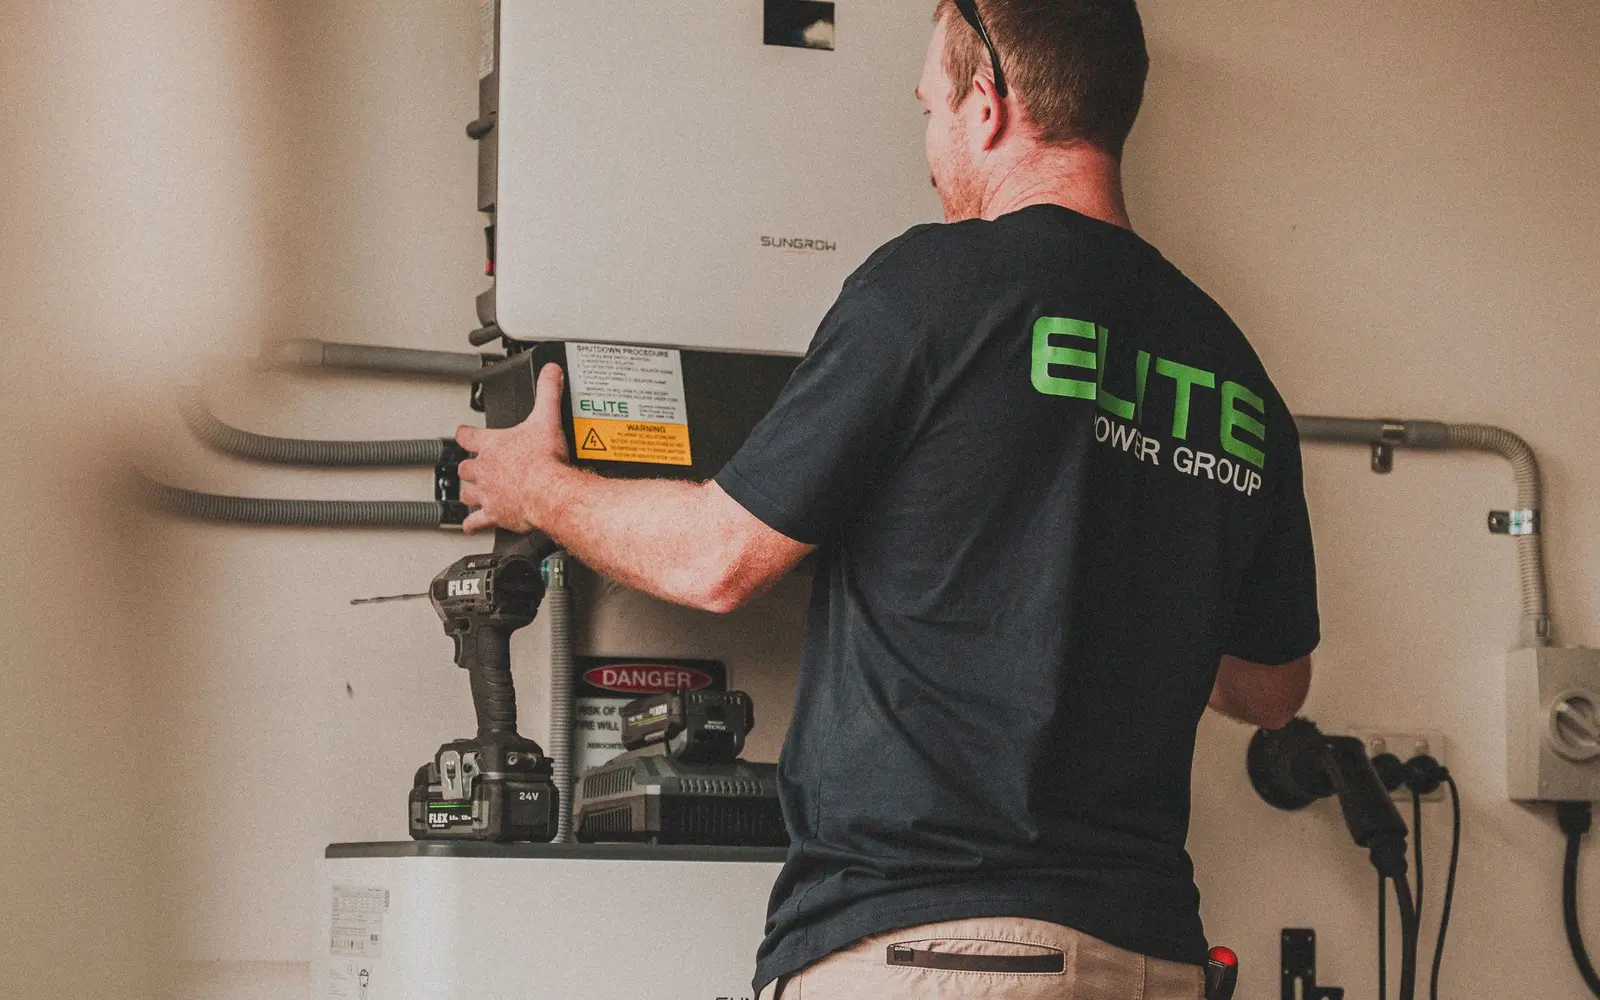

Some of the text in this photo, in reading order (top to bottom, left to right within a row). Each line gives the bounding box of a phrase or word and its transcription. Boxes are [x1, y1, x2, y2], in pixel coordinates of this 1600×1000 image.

[760, 235, 837, 251] SUNGROW
[576, 345, 621, 354] SHUTDOWN
[622, 348, 669, 358] PROCEDURE
[1031, 316, 1266, 469] ELITE
[580, 399, 629, 414] ELITE
[627, 424, 666, 433] WARNING
[1094, 412, 1262, 496] OWER GROUP
[448, 578, 481, 596] FLEX
[602, 670, 692, 688] DANGER
[602, 706, 616, 716] OF
[597, 721, 619, 731] WILL
[519, 791, 539, 801] 24V
[428, 812, 449, 824] FLEX
